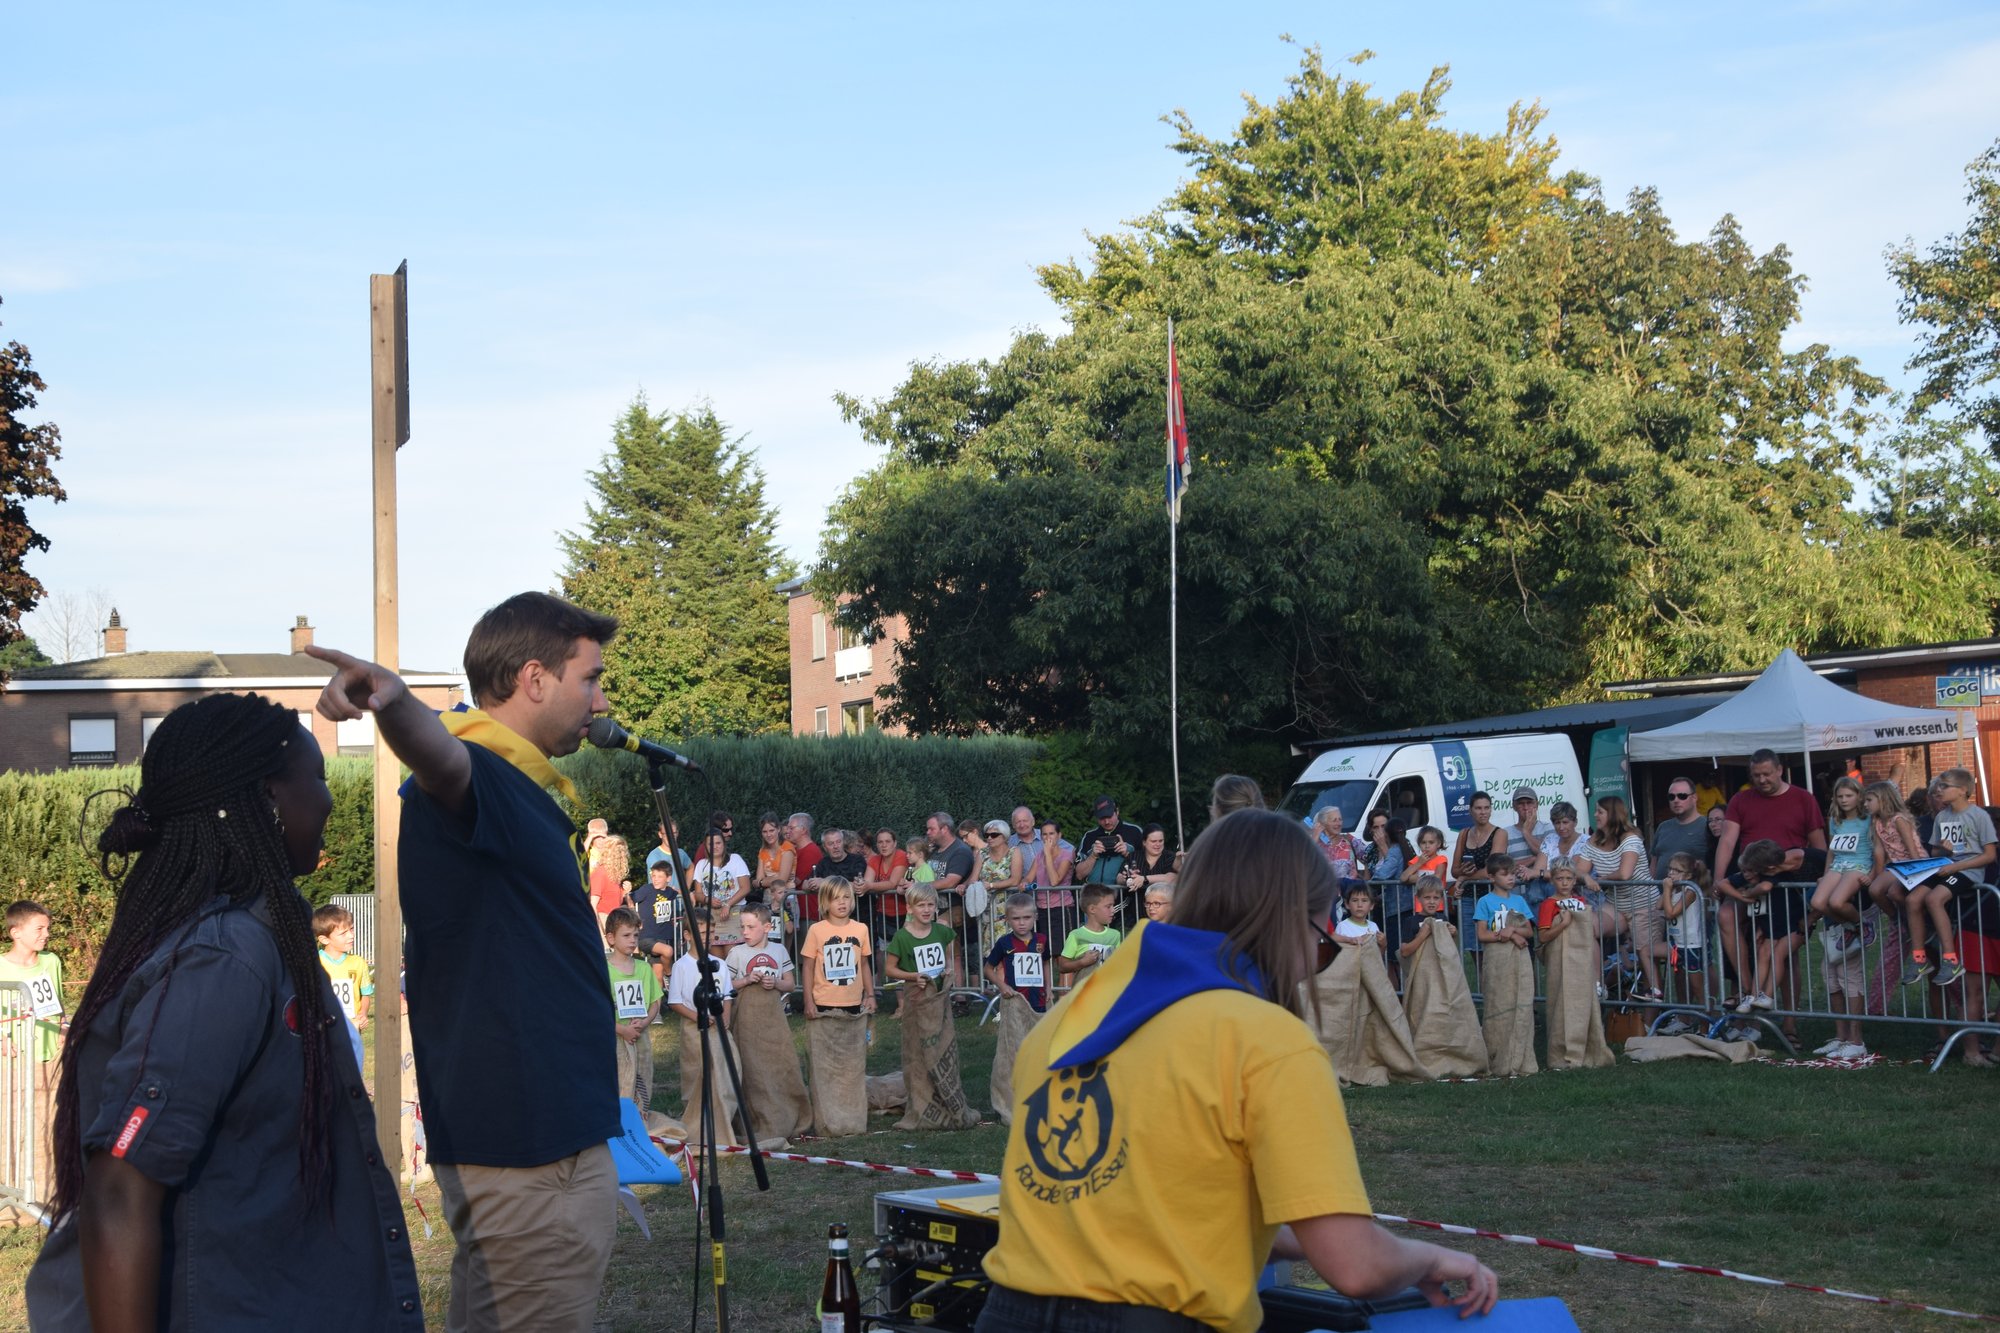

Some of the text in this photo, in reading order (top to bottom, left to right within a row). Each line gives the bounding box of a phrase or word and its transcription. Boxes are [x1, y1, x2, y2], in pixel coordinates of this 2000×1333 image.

[1937, 682, 1978, 699] TOOG
[1442, 756, 1467, 781] 50
[1484, 772, 1564, 794] De gezondste
[1834, 836, 1857, 849] 178
[1943, 826, 1963, 843] 262
[1945, 875, 1958, 885] 10
[657, 903, 671, 917] 200
[826, 947, 851, 968] 127
[918, 946, 943, 968] 152
[1017, 956, 1041, 975] 121
[618, 984, 643, 1006] 124
[117, 1116, 142, 1150] CHIRO
[1015, 1163, 1061, 1204] Ronde
